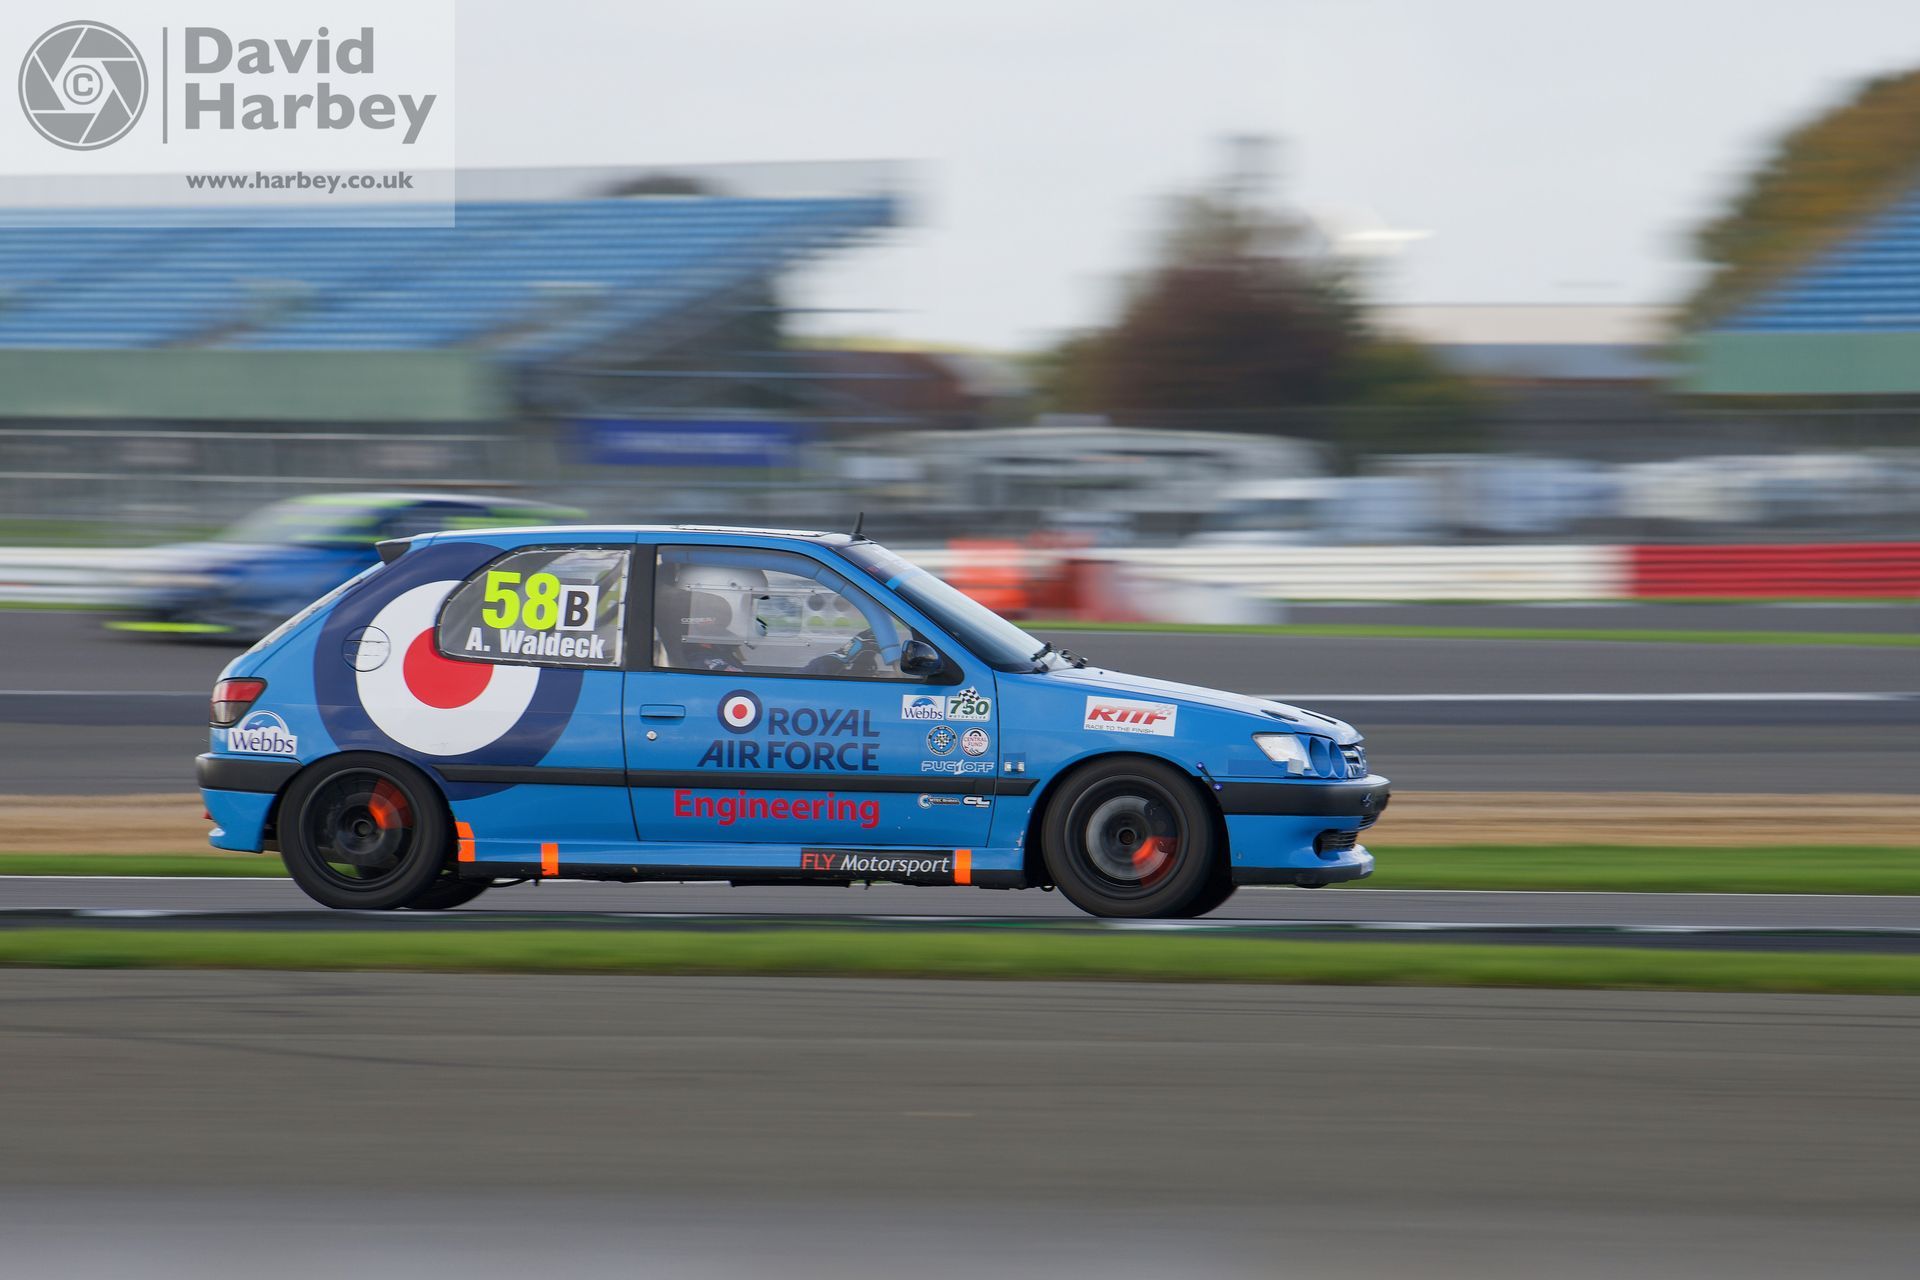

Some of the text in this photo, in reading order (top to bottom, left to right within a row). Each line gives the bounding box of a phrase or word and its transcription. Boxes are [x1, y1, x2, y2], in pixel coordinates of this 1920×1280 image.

[482, 571, 560, 630] 58
[564, 590, 590, 626] B
[465, 627, 605, 659] A. Waldeck
[768, 708, 880, 737] ROYAL
[904, 708, 943, 719] Webbs
[950, 700, 989, 715] 750
[232, 731, 294, 753] Webbs
[697, 740, 880, 771] AIR FORCE
[674, 789, 880, 828] Engineering
[802, 853, 950, 876] FLY Motorsport
